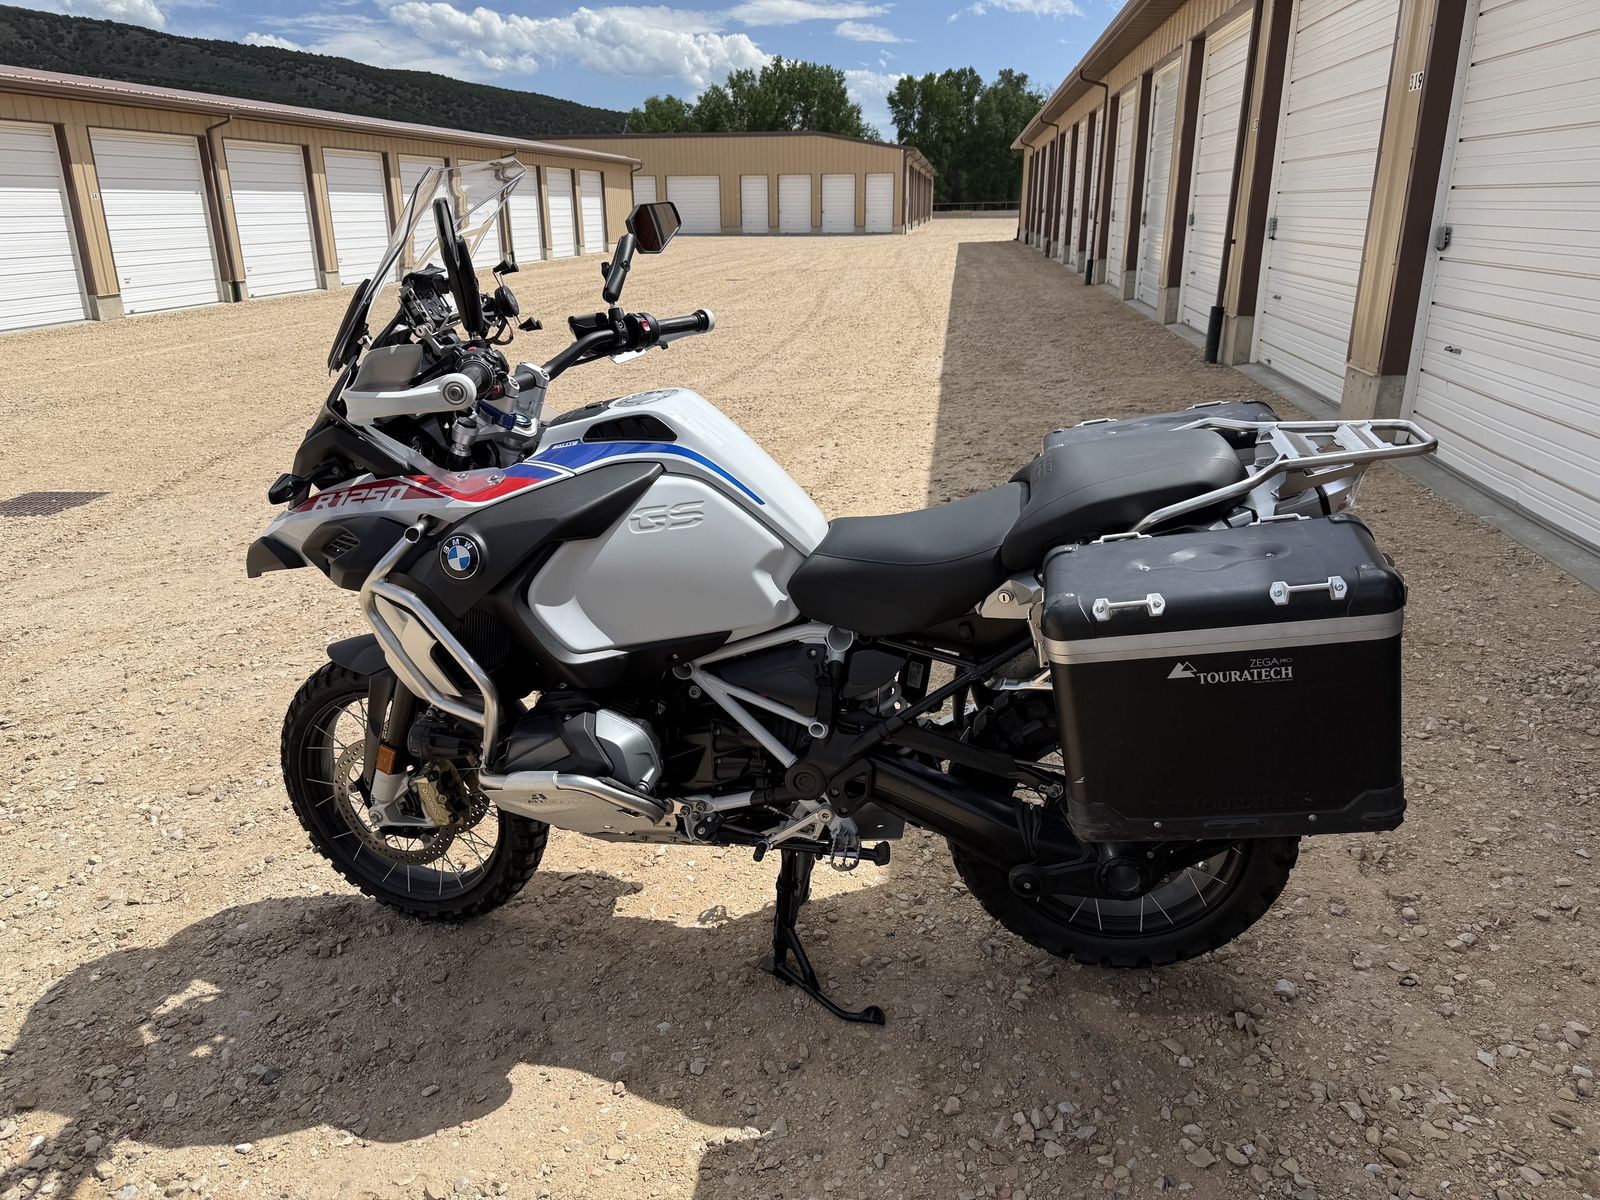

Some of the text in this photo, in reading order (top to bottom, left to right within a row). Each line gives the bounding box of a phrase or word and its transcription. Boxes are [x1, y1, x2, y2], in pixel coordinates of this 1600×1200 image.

[628, 500, 705, 535] GS
[443, 538, 473, 554] BMW
[1249, 657, 1280, 668] ZEGA
[1197, 666, 1293, 685] TOURATECH
